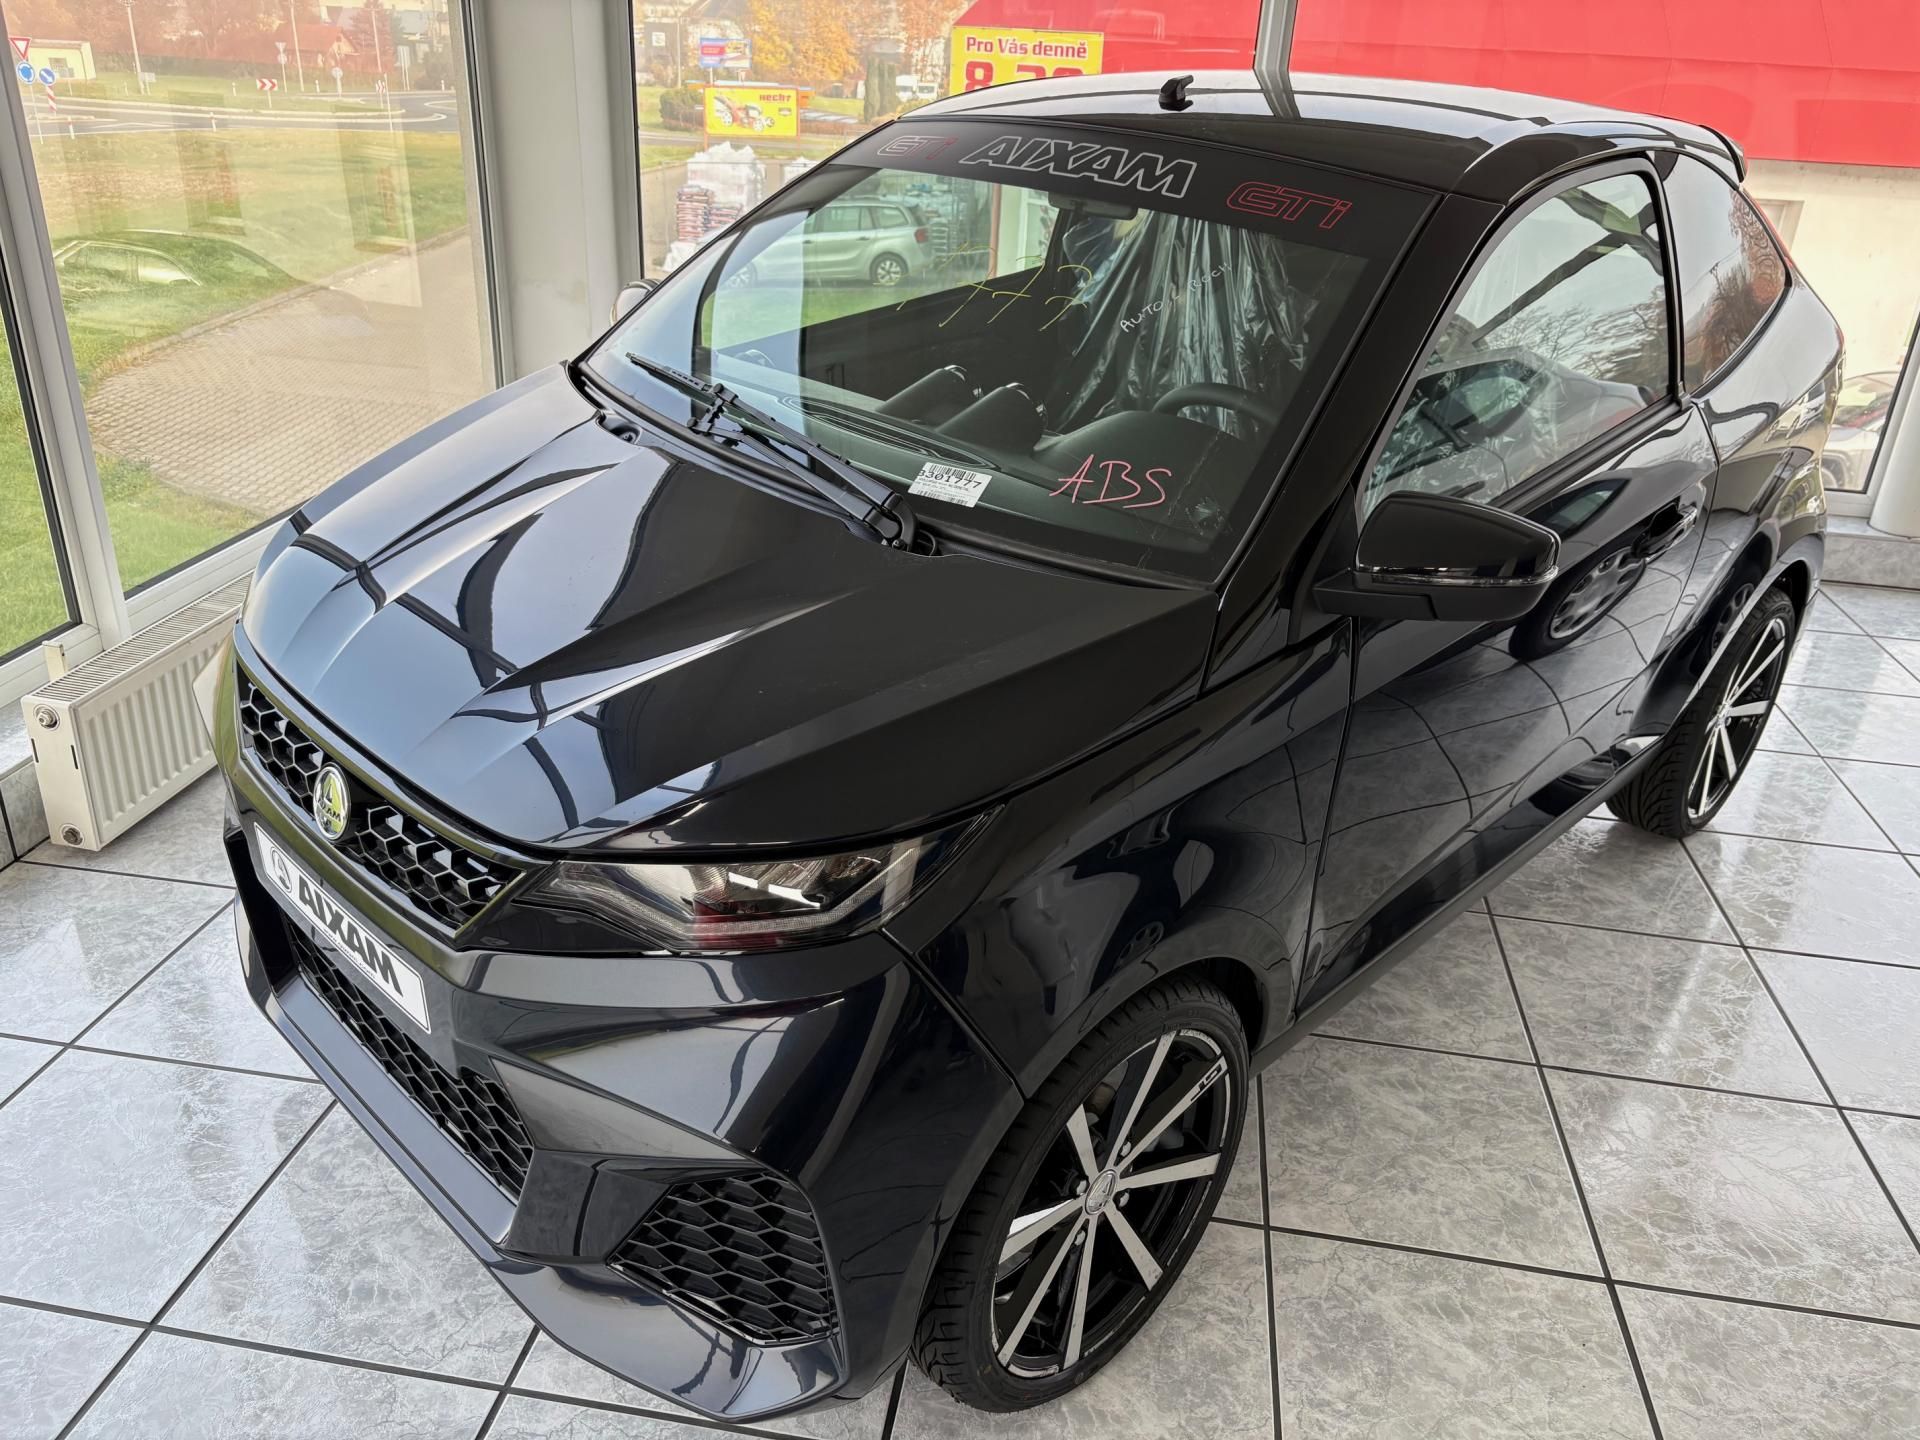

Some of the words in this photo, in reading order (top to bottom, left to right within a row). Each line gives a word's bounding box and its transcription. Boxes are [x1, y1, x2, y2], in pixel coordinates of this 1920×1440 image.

[966, 36, 994, 53] Pro
[998, 37, 1028, 55] Vás
[1032, 40, 1087, 59] denně
[959, 135, 1198, 199] AIXAM
[1226, 181, 1353, 230] GTi
[1119, 300, 1164, 333] AUTO
[1049, 453, 1173, 509] ABS
[298, 873, 404, 998] AIXAM
